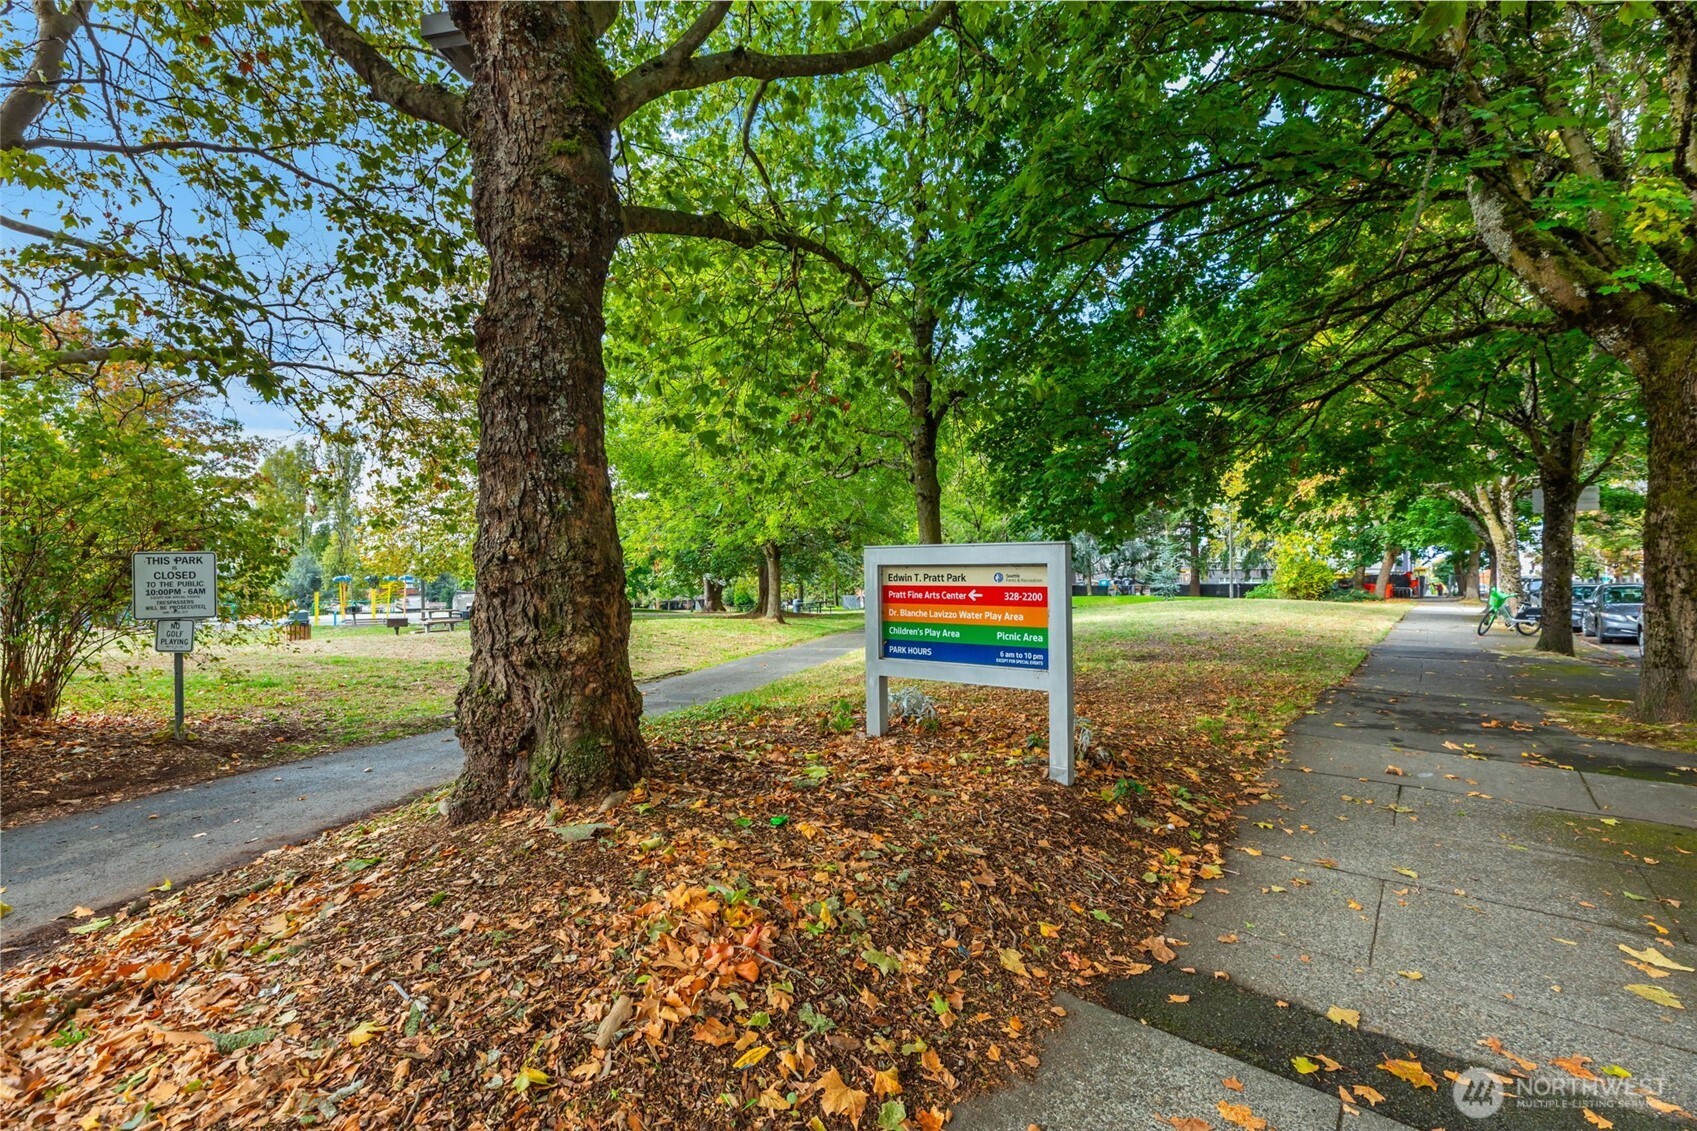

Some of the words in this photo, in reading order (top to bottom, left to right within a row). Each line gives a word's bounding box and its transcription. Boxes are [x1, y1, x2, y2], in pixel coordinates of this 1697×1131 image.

[146, 556, 170, 565] THIS
[175, 556, 203, 564] PARK
[153, 571, 196, 580] CLOSED
[888, 573, 912, 582] Edwin
[914, 573, 922, 582] T.
[924, 573, 944, 582] Pratt
[947, 573, 966, 582] Park
[888, 591, 906, 599] Pratt
[908, 591, 923, 599] Fine
[924, 591, 940, 599] Arts
[942, 591, 966, 600] Center
[1004, 592, 1043, 602] 328-2200
[888, 608, 899, 616] Dr.
[900, 609, 928, 617] Blanche
[929, 610, 957, 618] Lavizzo
[959, 611, 983, 620] Water
[984, 611, 1002, 622] Play
[1004, 612, 1024, 621] Area
[171, 622, 180, 630] NO
[889, 626, 923, 636] Children's
[924, 628, 941, 638] Play
[942, 629, 960, 638] Area
[997, 631, 1021, 641] Picnic
[1023, 632, 1043, 642] Area
[889, 645, 907, 654] PARK
[907, 647, 932, 656] HOURS
[1000, 650, 1004, 658] 6
[1024, 652, 1032, 660] 10
